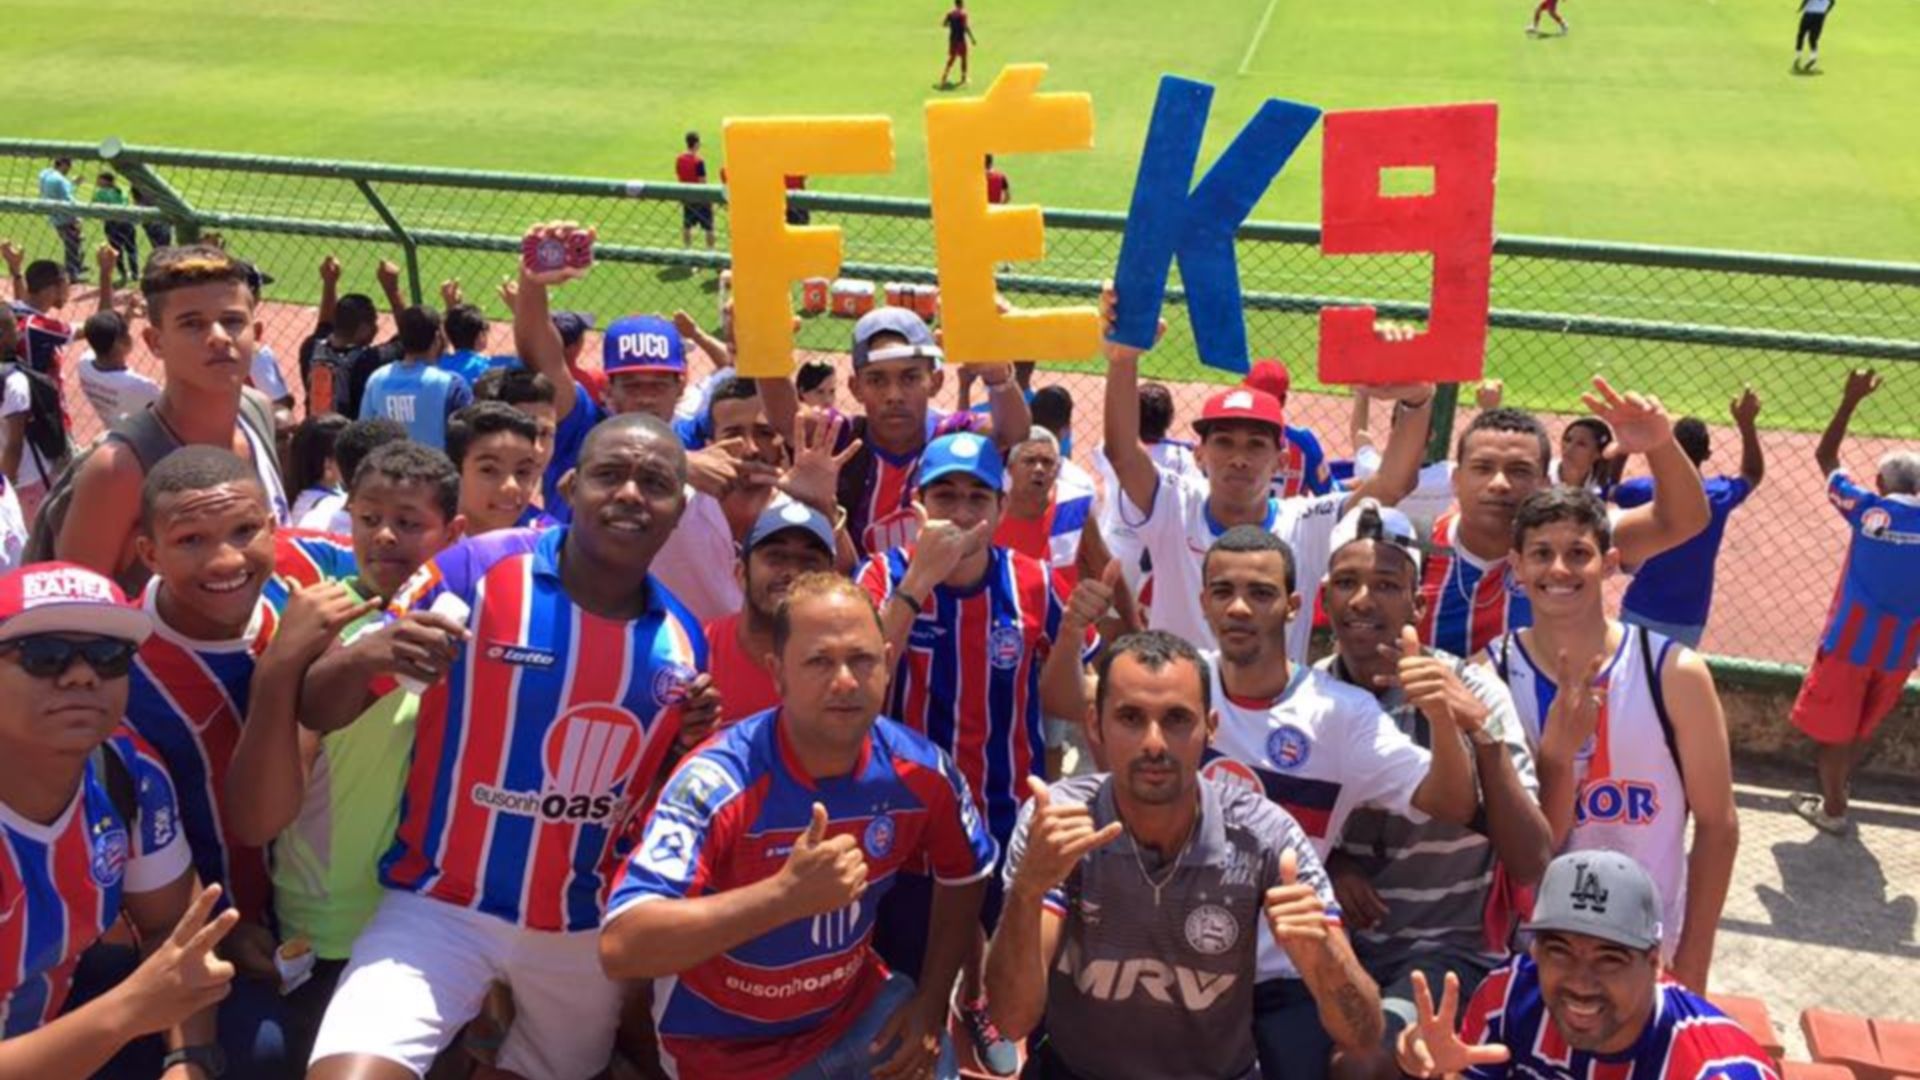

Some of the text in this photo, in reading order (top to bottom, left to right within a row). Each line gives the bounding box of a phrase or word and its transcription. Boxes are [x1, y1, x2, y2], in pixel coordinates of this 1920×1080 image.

[619, 332, 669, 359] PUCO
[1570, 863, 1609, 914] LA
[1057, 949, 1238, 1011] MRV
